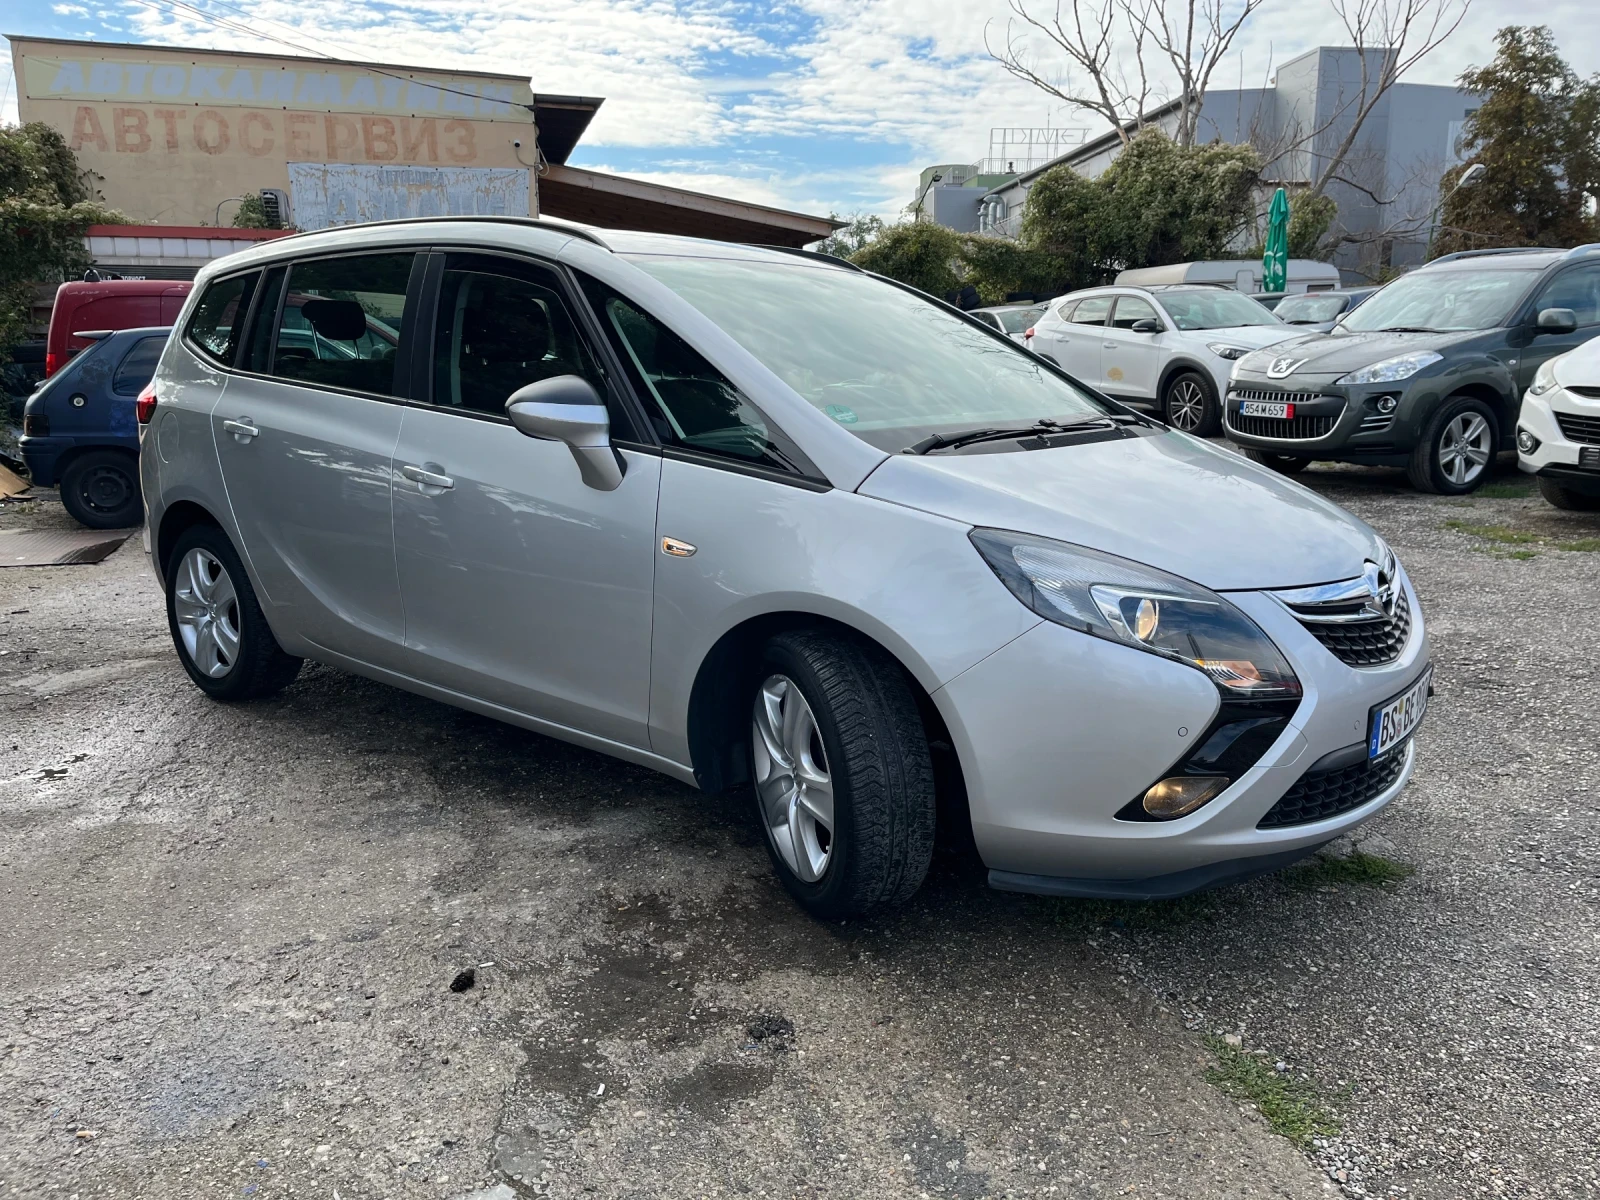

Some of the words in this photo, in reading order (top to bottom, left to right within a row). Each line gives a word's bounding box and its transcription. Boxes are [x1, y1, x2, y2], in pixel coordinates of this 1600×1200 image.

[70, 106, 478, 162] АВТОСЕРВИЗ
[1380, 706, 1397, 748] BS
[1403, 690, 1416, 731] BE
